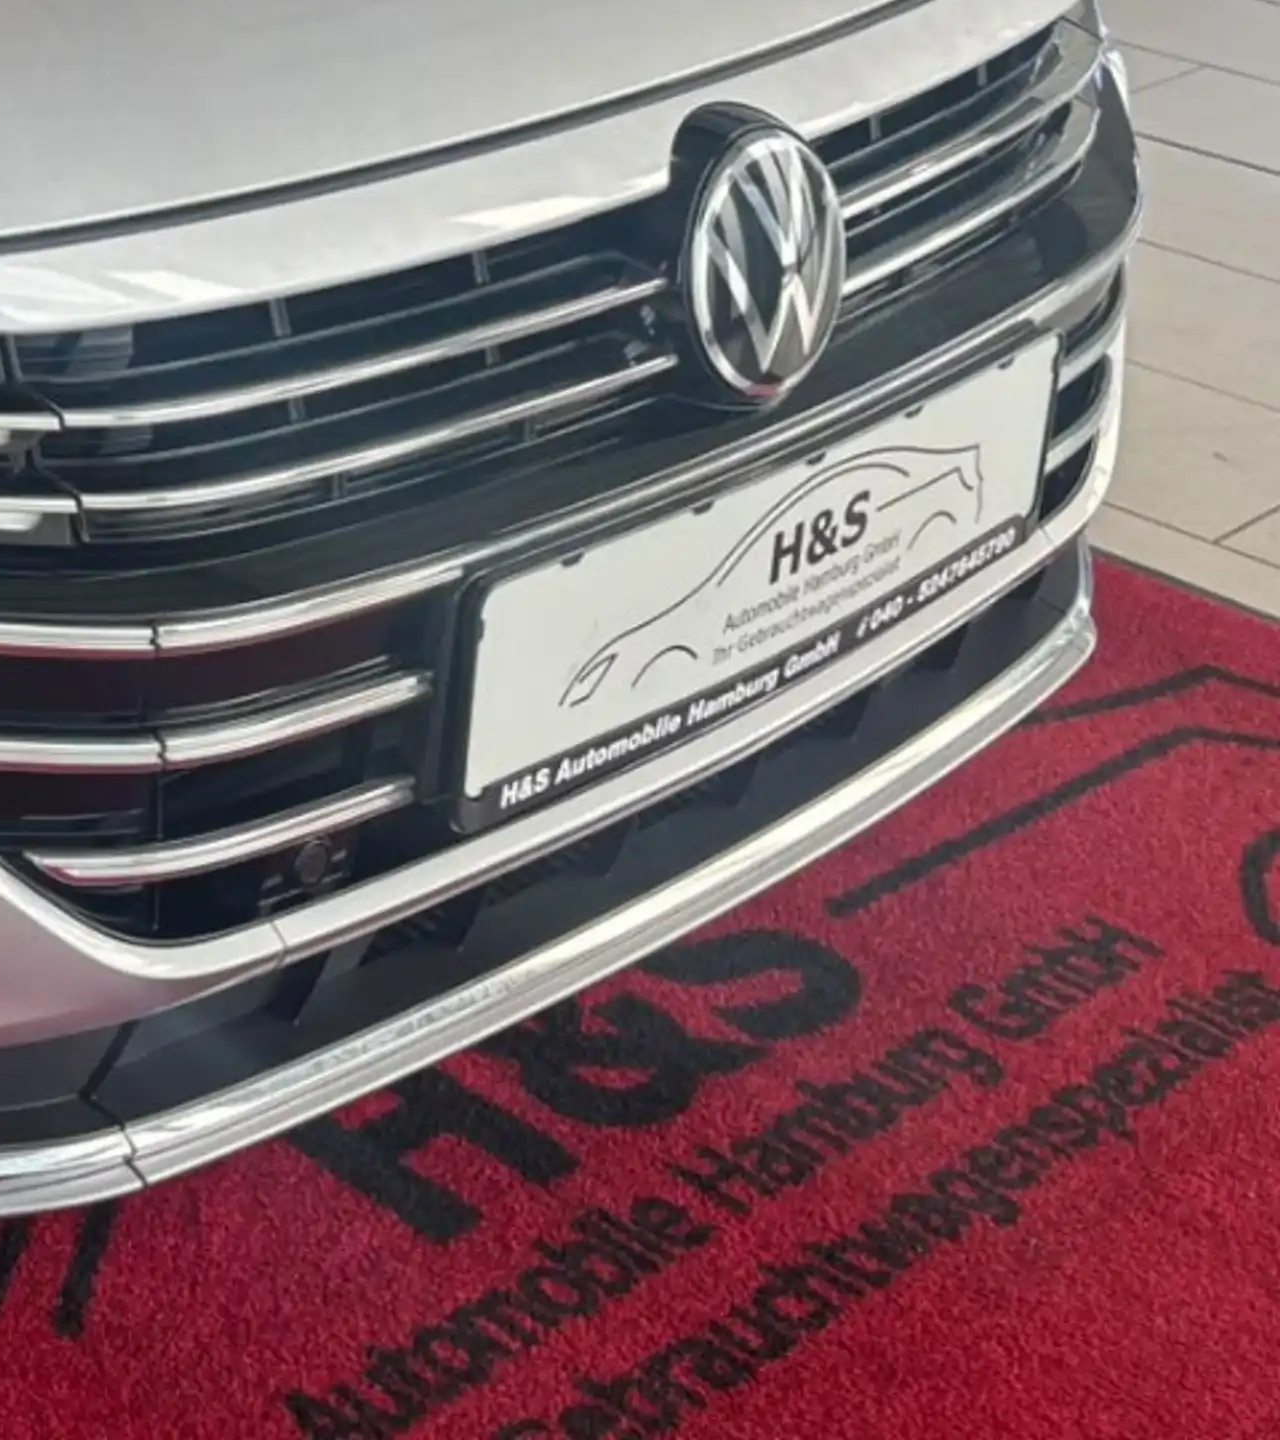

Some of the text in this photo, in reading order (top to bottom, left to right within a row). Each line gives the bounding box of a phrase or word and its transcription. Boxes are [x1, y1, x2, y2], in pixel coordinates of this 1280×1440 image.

[768, 489, 871, 586] H&S
[499, 768, 551, 810] H&S
[553, 712, 682, 786] Automobile
[686, 666, 780, 727] Hamburg
[783, 628, 841, 679] GmbH
[283, 913, 1166, 1440] Automobile Hamburg GmbH
[286, 928, 861, 1244] H&S
